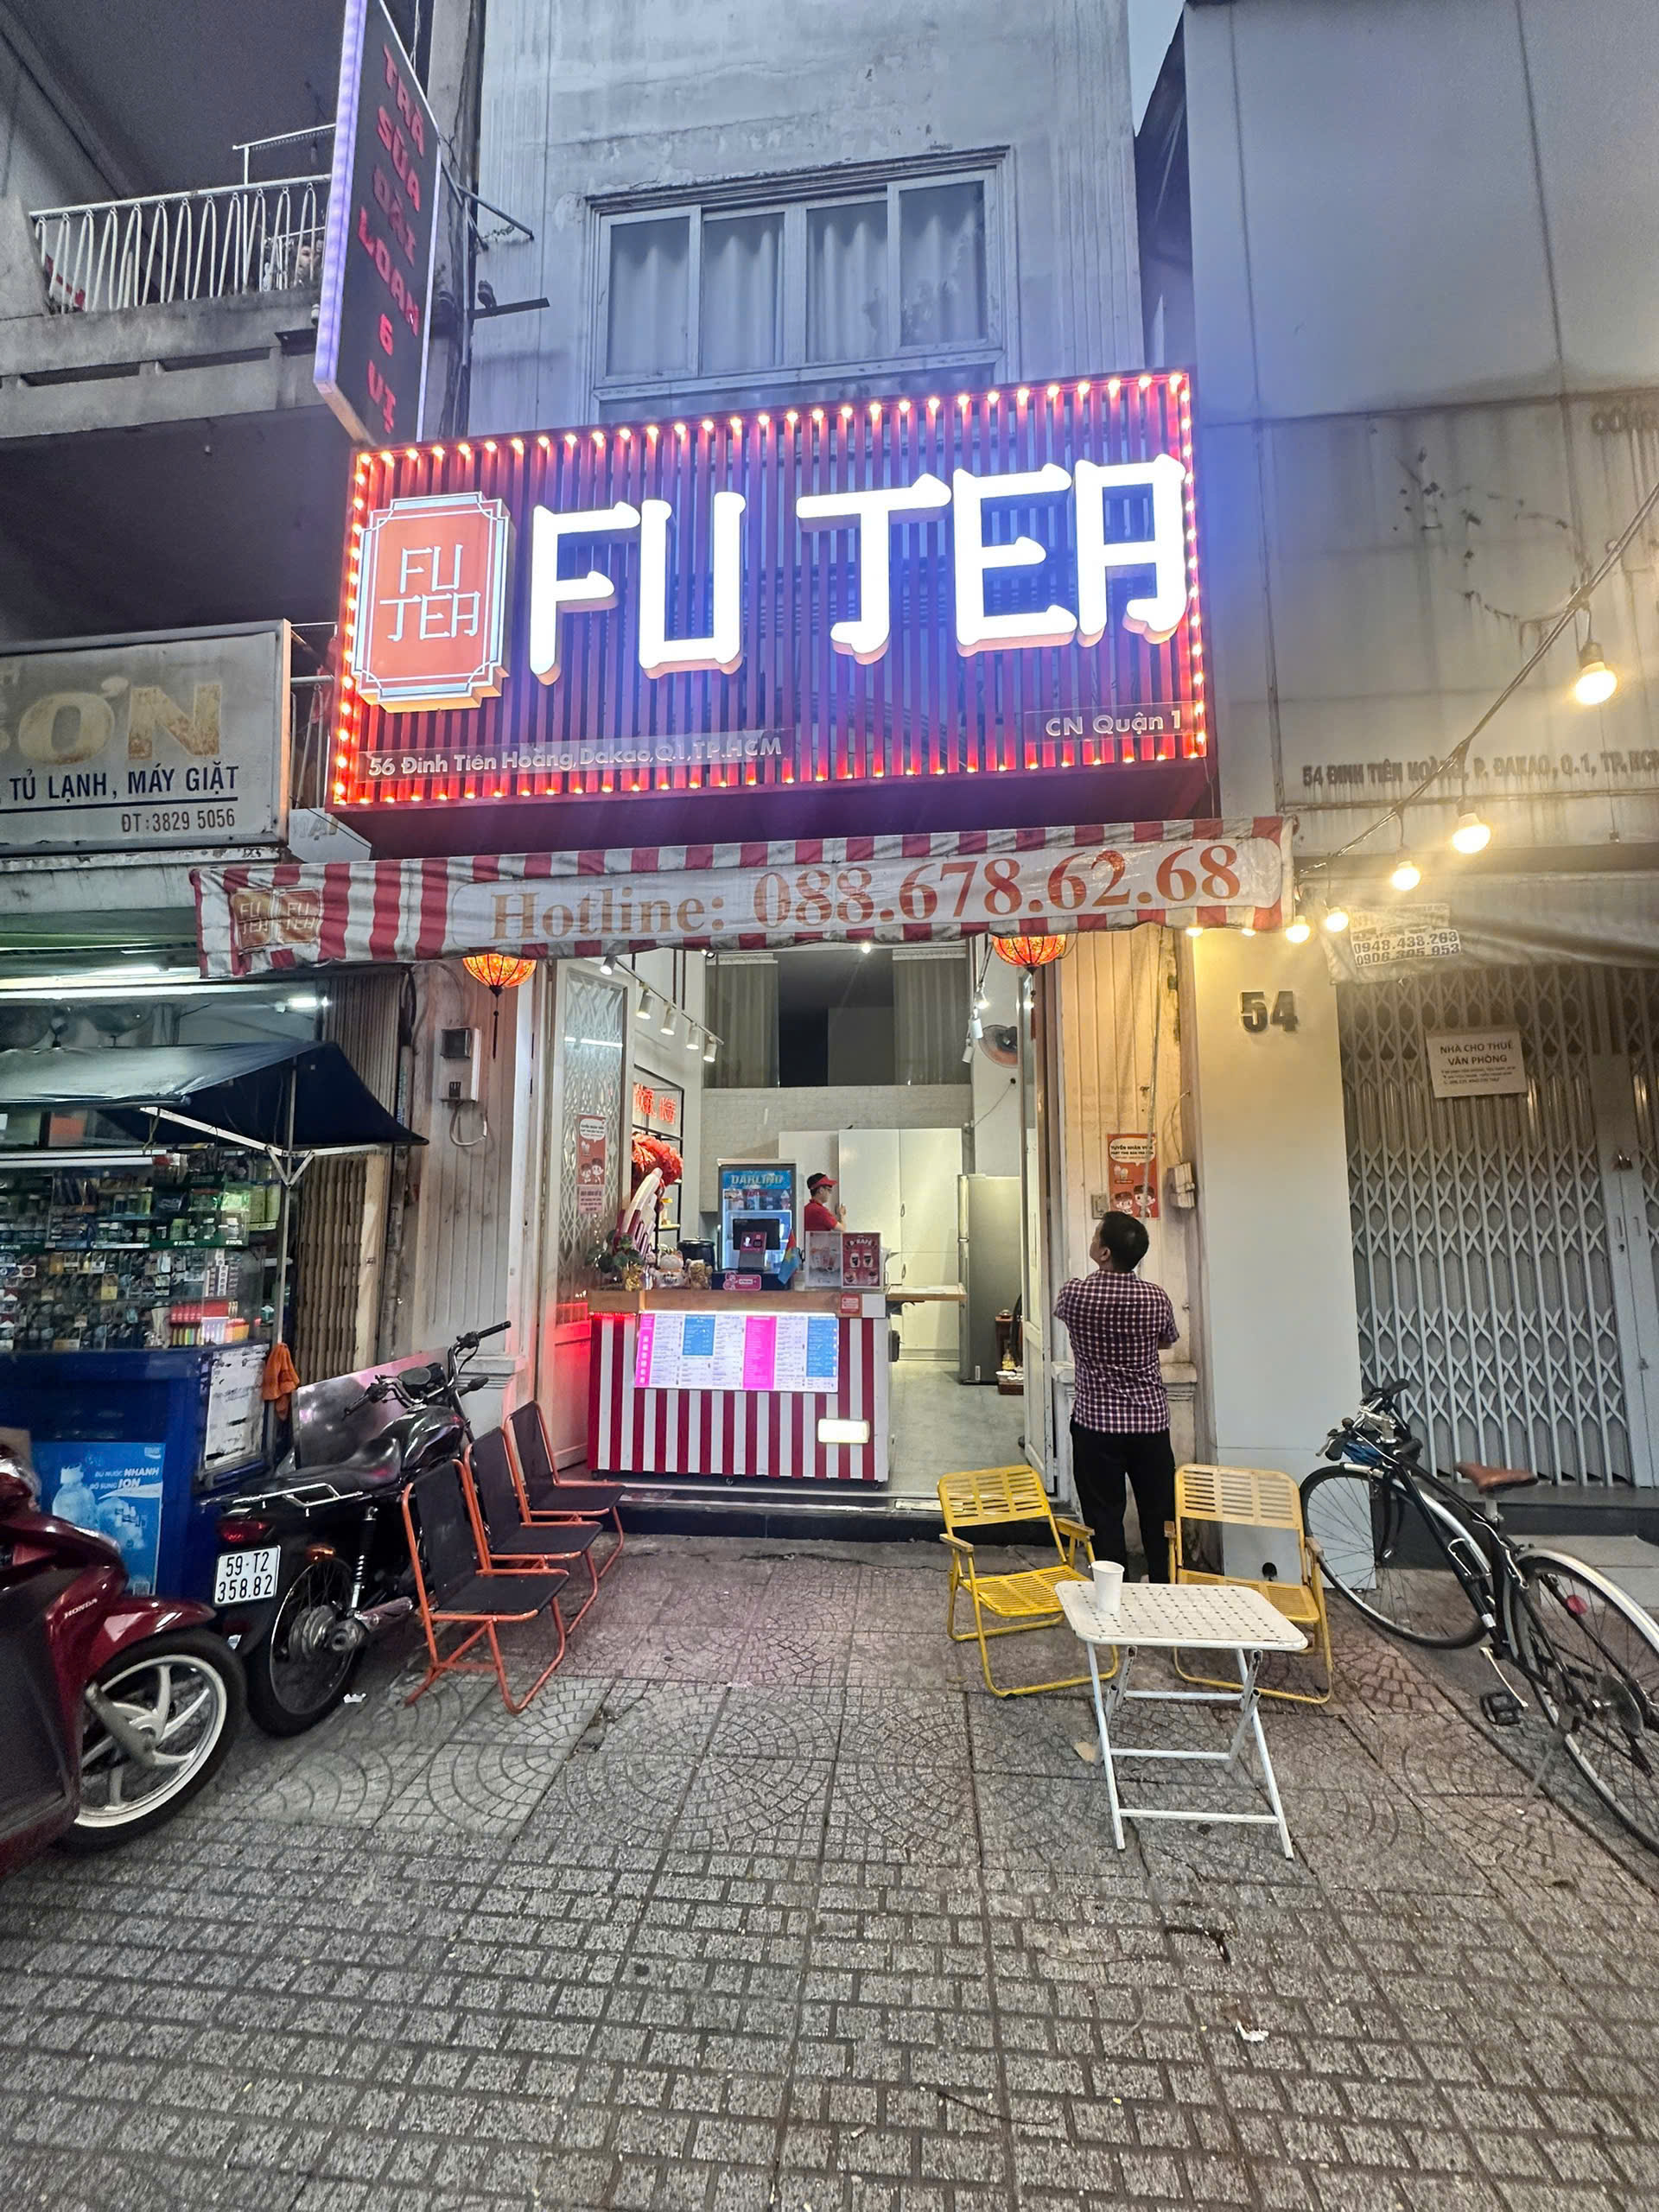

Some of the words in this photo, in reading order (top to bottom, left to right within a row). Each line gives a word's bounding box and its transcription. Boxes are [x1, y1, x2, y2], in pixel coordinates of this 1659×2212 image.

[359, 204, 420, 338] LOAN
[379, 313, 394, 357] 6
[400, 543, 464, 594] FU
[529, 491, 746, 677] FU
[796, 454, 1186, 655] TEA
[379, 590, 481, 642] TEA
[0, 676, 222, 766] ƠN
[1046, 716, 1084, 736] CN
[1093, 712, 1164, 734] Quận
[1171, 710, 1181, 729] 1
[368, 757, 396, 777] 56
[401, 753, 448, 774] Đinh
[454, 753, 497, 772] Tiên
[1302, 764, 1324, 786] 54
[1367, 758, 1403, 784] TIÊN
[10, 768, 36, 802] TỦ
[128, 763, 175, 794] MÁY
[186, 761, 239, 795] GIẶT
[197, 808, 235, 830] 5056
[490, 887, 726, 942] Hotline:
[753, 844, 1241, 929] 088.678.62.68
[240, 901, 262, 918] FU
[287, 901, 310, 917] FU
[1239, 990, 1298, 1033] 54
[1440, 1043, 1462, 1055] NHÀ
[1464, 1043, 1485, 1052] CHO
[1471, 1054, 1508, 1065] PHÒNG
[118, 1478, 141, 1489] ION
[124, 1467, 160, 1477] NHANH
[217, 1573, 273, 1602] 358.82
[64, 1598, 99, 1620] HONDA
